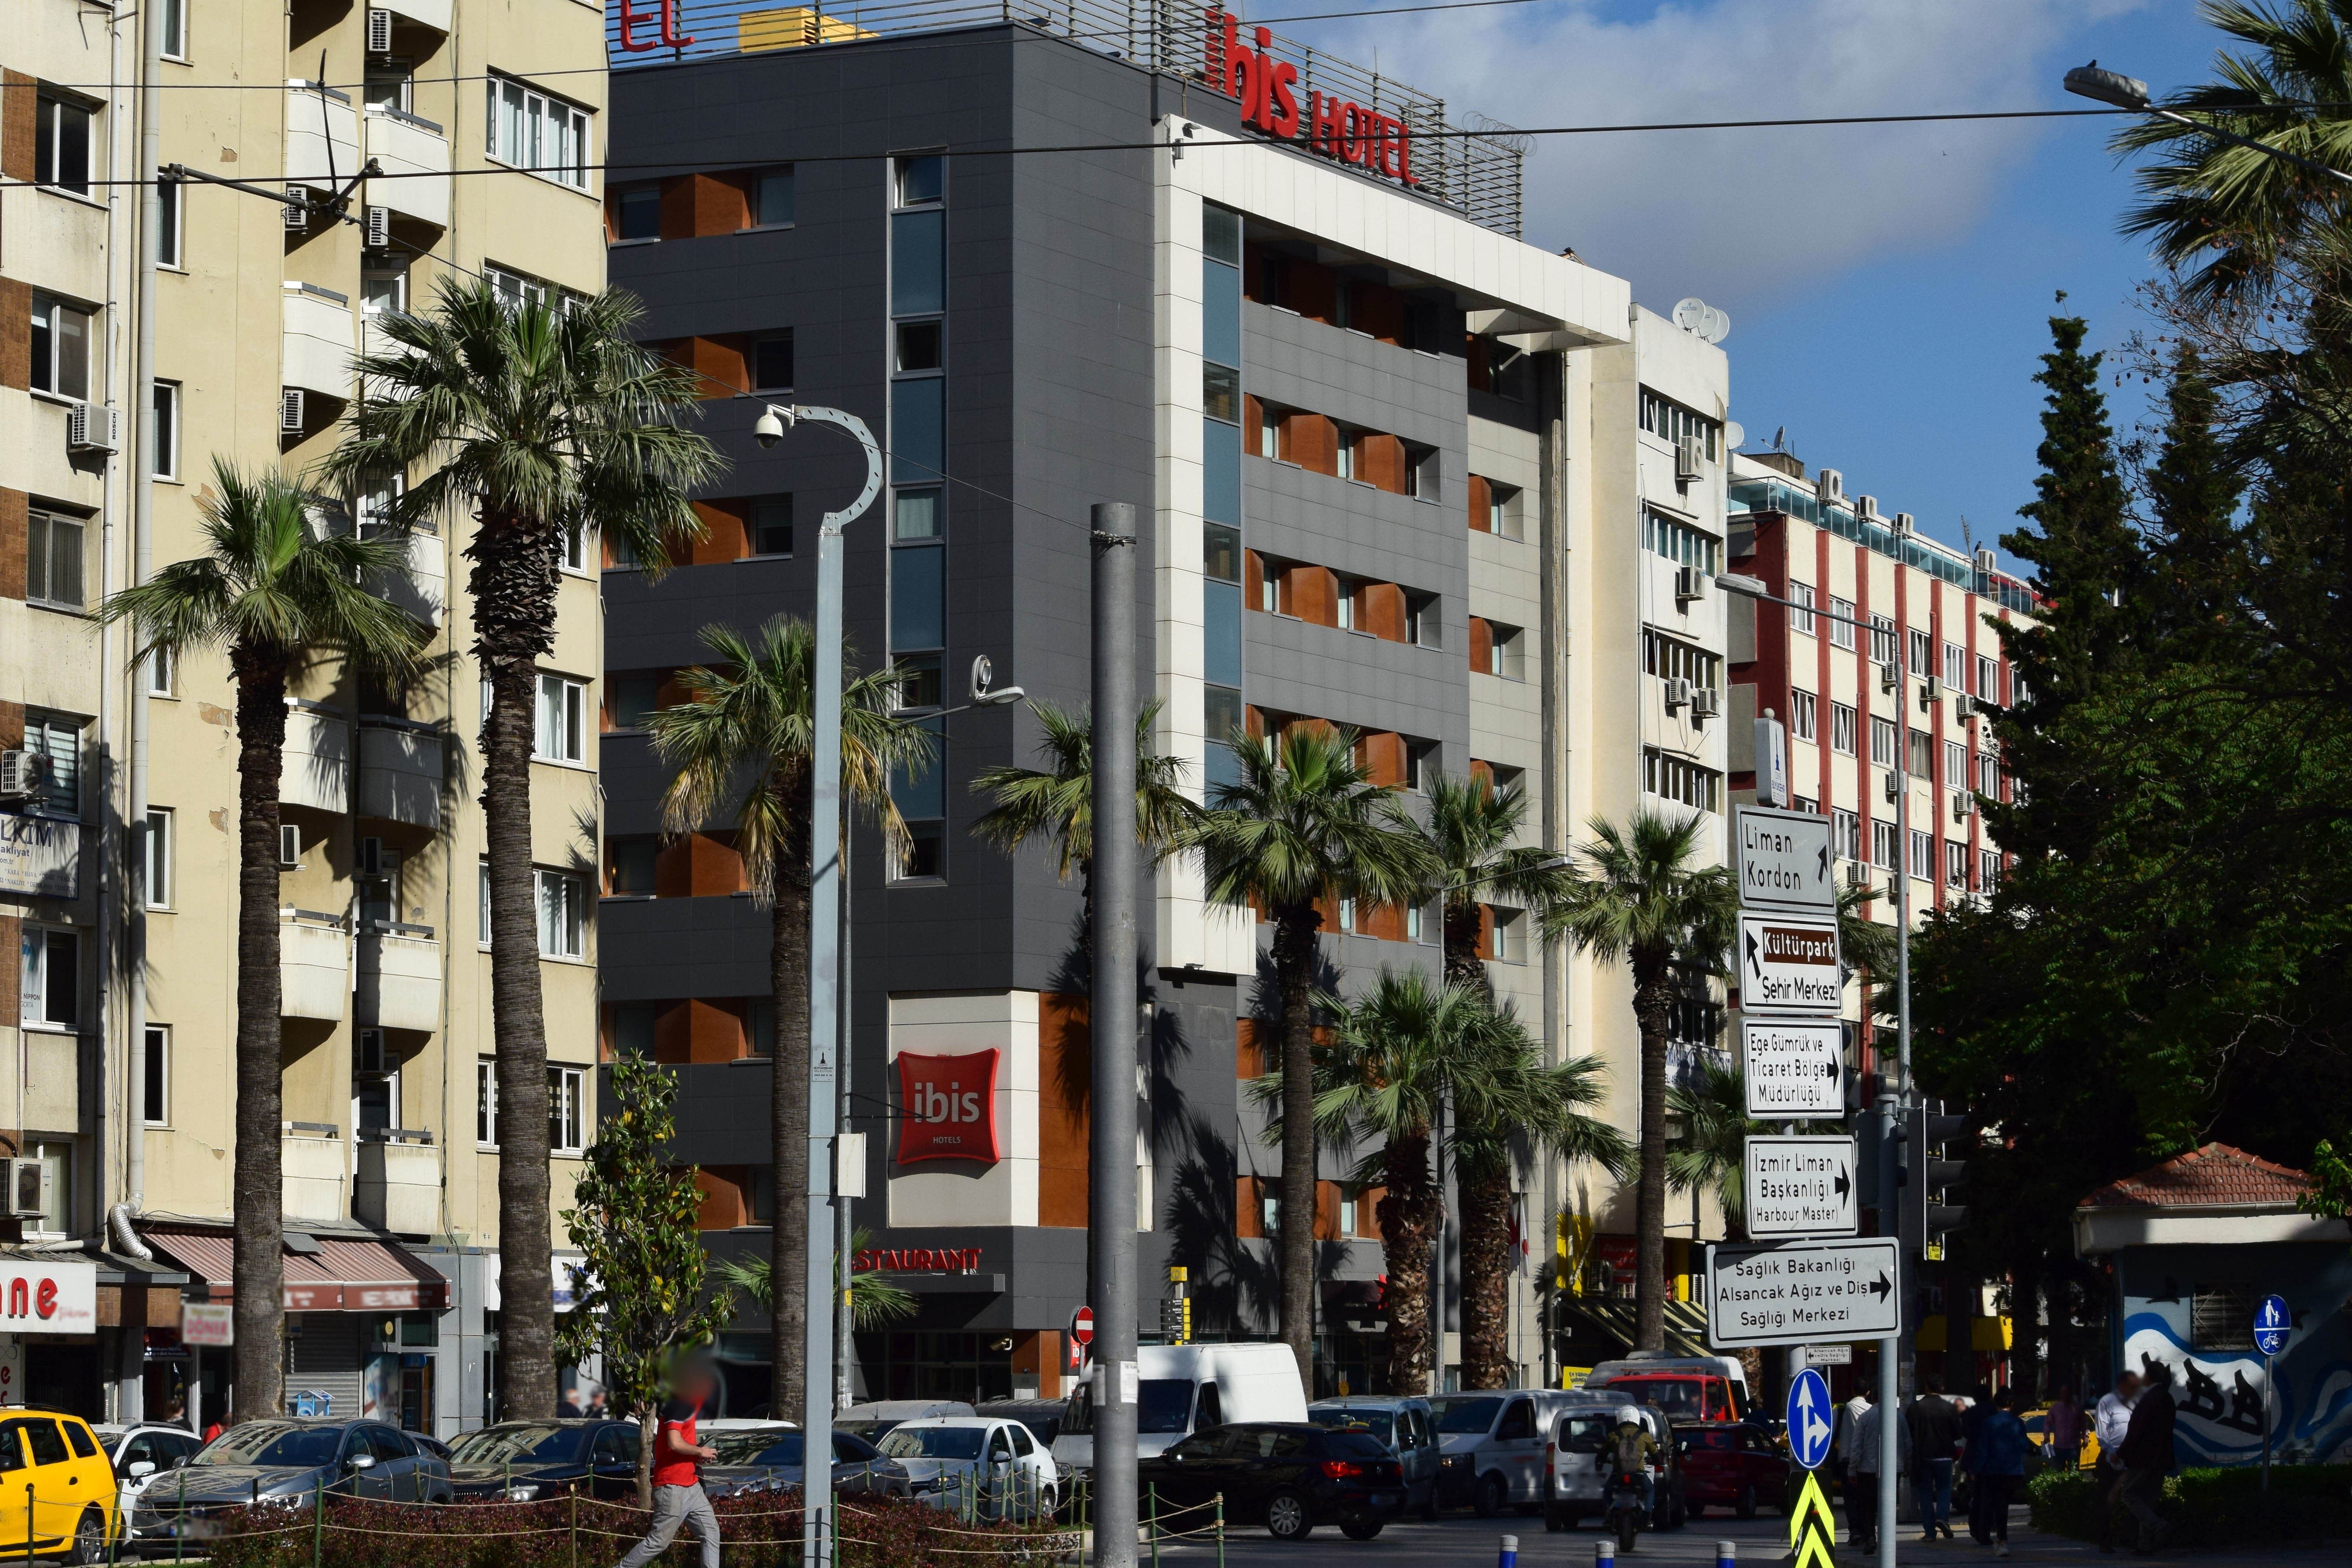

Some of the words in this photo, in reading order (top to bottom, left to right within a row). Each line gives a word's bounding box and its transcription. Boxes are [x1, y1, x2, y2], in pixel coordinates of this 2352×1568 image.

[1312, 90, 1419, 184] HOTEL
[1746, 824, 1792, 853] Liman
[1, 845, 30, 857] akliyat
[1748, 860, 1801, 890] Kordon
[1763, 932, 1834, 961] Kültürpark
[24, 992, 40, 1000] NİPPON
[1763, 976, 1791, 1003] Şehir
[1794, 977, 1839, 1001] Merkezi
[1750, 1034, 1768, 1056] Ege
[1771, 1033, 1809, 1052] Gümrük
[1812, 1040, 1822, 1052] ve
[1750, 1058, 1792, 1077] Ticaret
[1795, 1058, 1825, 1082] Bölge
[914, 1082, 980, 1123] ibis
[1758, 1083, 1821, 1106] Müdürlüğü
[1755, 1148, 1790, 1172] İzmir
[1796, 1152, 1833, 1172] Liman
[1761, 1178, 1829, 1201] Başkanlığı
[1753, 1207, 1799, 1225] (Harbour
[1802, 1205, 1838, 1222] Master)
[852, 1249, 982, 1270] STAURANT
[1735, 1260, 1780, 1280] Sağlık
[1787, 1257, 1855, 1274] Bakanlığı
[0, 1277, 58, 1319] ne
[1719, 1284, 1785, 1302] Alsancak
[1790, 1283, 1822, 1302] Ağız
[1827, 1284, 1843, 1296] ve
[1847, 1280, 1868, 1298] Diş
[1741, 1309, 1786, 1329] Sağlığı
[1793, 1306, 1850, 1322] Merkezi
